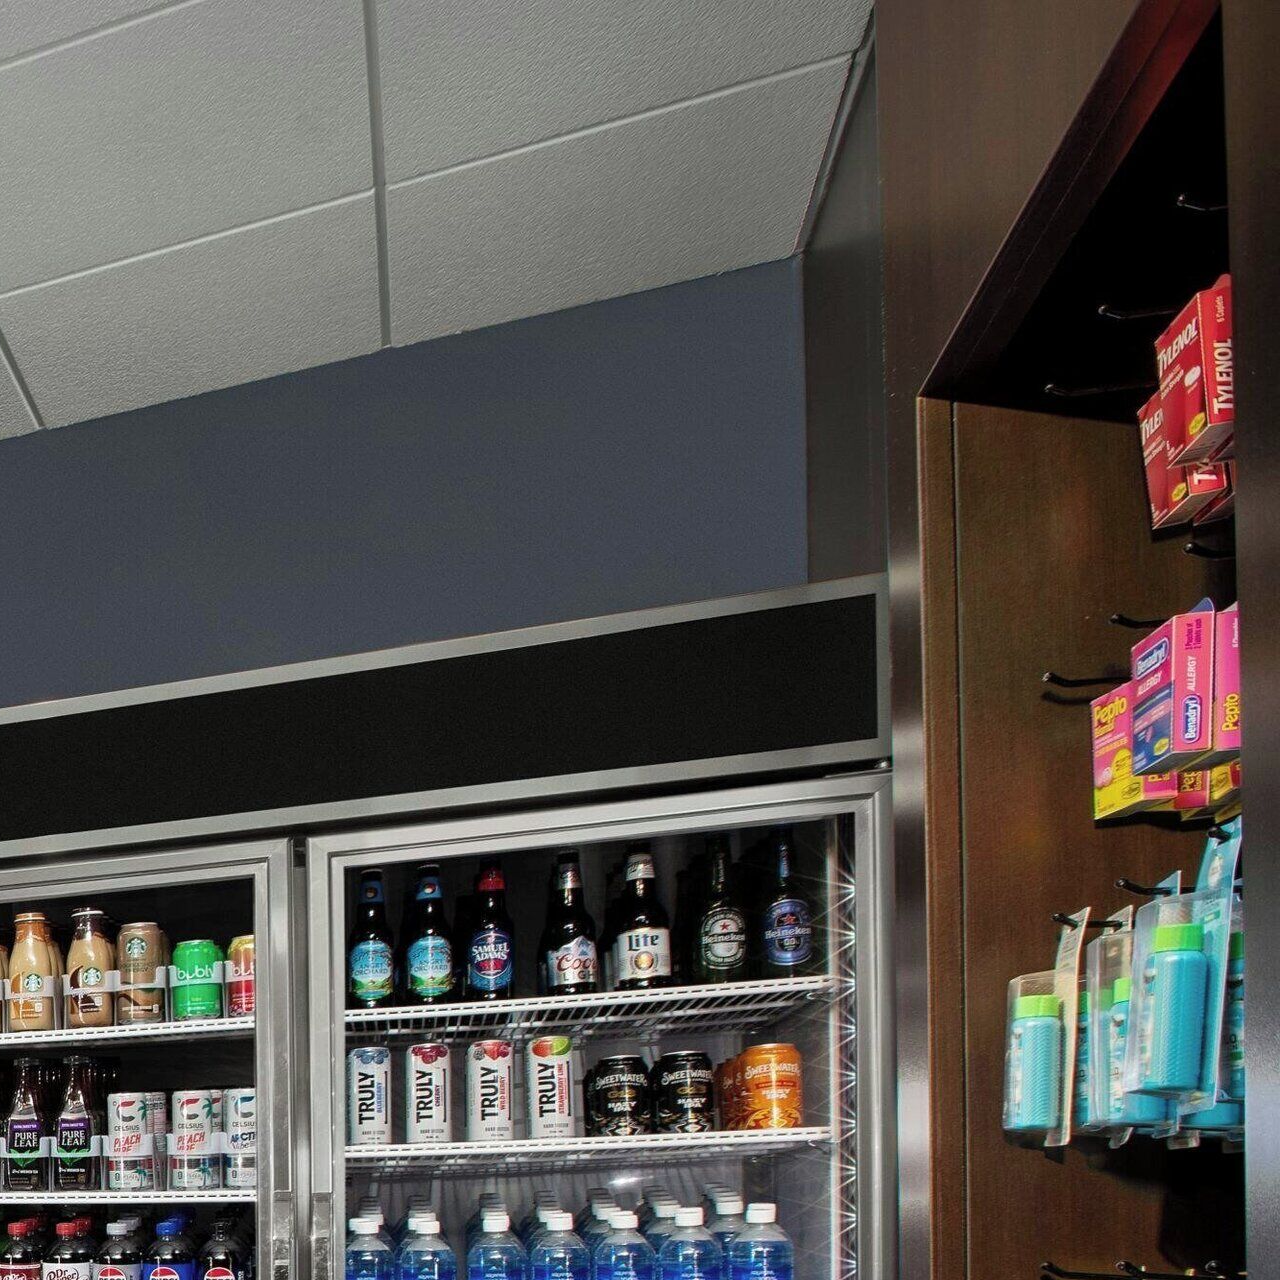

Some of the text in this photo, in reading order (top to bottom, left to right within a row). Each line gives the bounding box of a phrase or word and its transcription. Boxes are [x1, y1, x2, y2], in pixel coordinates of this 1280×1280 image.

[1157, 317, 1198, 377] TYLENOL
[1213, 337, 1233, 414] TYLENOL
[1187, 655, 1196, 691] ALLERGY
[1185, 698, 1200, 739] Benadryl
[1221, 693, 1240, 732] Pepto
[702, 933, 746, 945] Heineken
[765, 926, 812, 940] Heineken
[471, 942, 510, 954] SAMUEL
[474, 951, 508, 961] ADAMS
[354, 969, 388, 977] ORCHARD
[662, 1069, 714, 1086] SWEETWATER
[745, 1063, 800, 1080] SWEETWATER
[538, 1062, 556, 1117] TRULY
[595, 1073, 647, 1090] SWEETWATER
[358, 1071, 375, 1124] TRULY
[416, 1069, 433, 1123] TRULY
[481, 1067, 499, 1121] TRULY
[14, 1132, 38, 1140] PURE
[62, 1130, 86, 1139] PURE
[114, 1124, 140, 1132] CELSIUS
